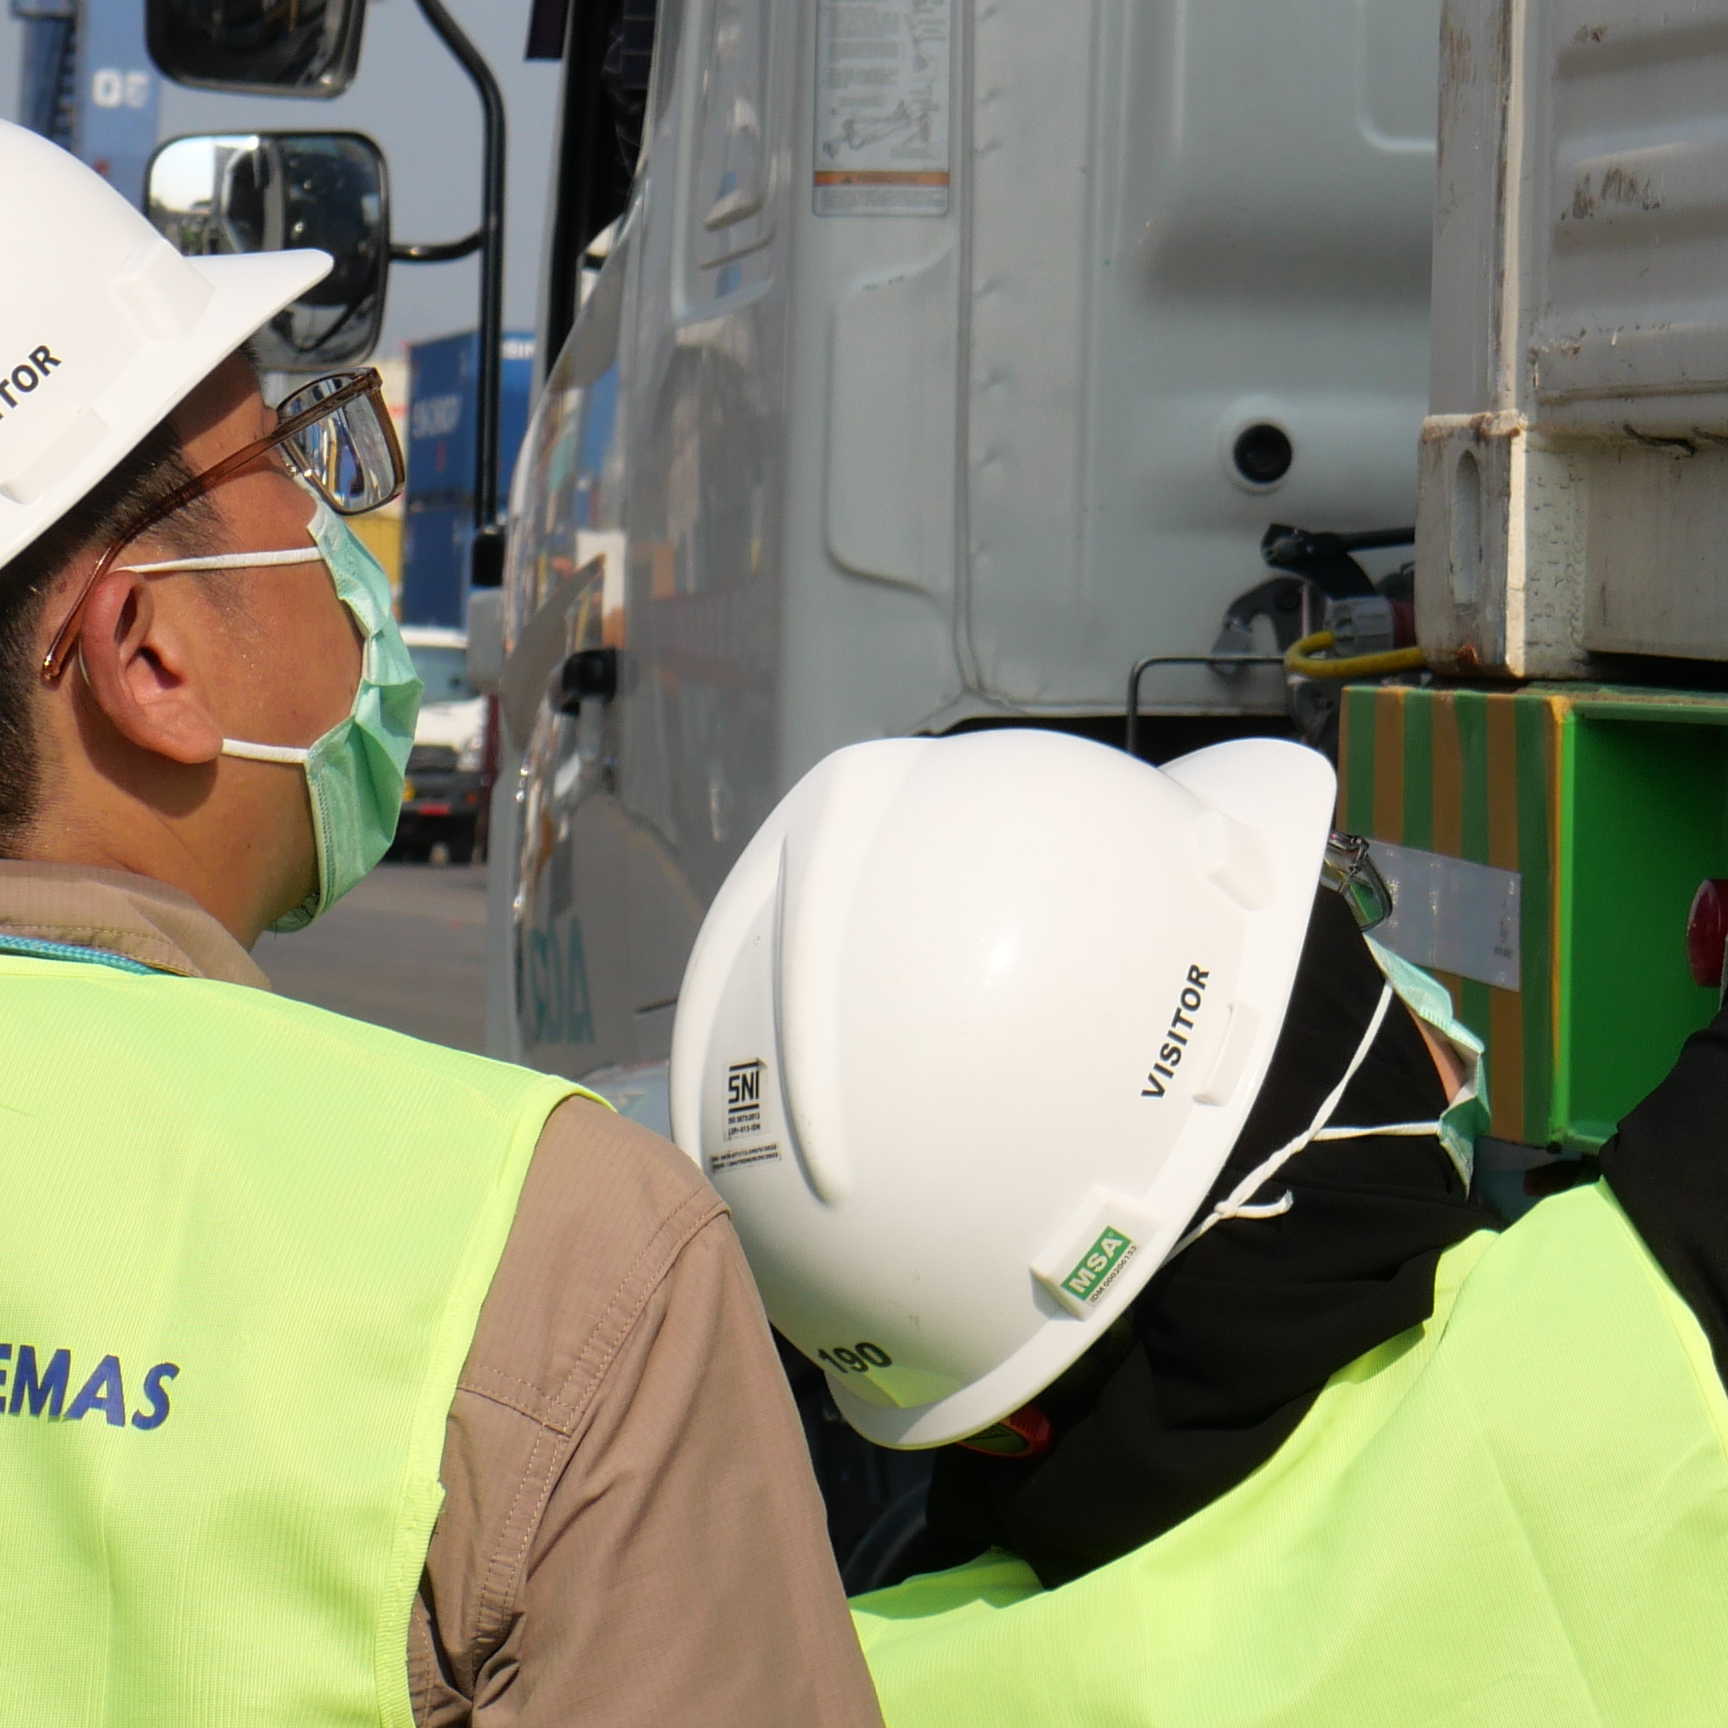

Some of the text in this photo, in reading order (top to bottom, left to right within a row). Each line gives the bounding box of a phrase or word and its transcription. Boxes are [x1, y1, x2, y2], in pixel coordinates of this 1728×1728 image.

[0, 345, 62, 421] TOR
[1140, 962, 1211, 1100] VISITOR
[728, 1070, 760, 1104] SNI
[1068, 1231, 1124, 1295] MSA
[818, 1342, 892, 1374] 190
